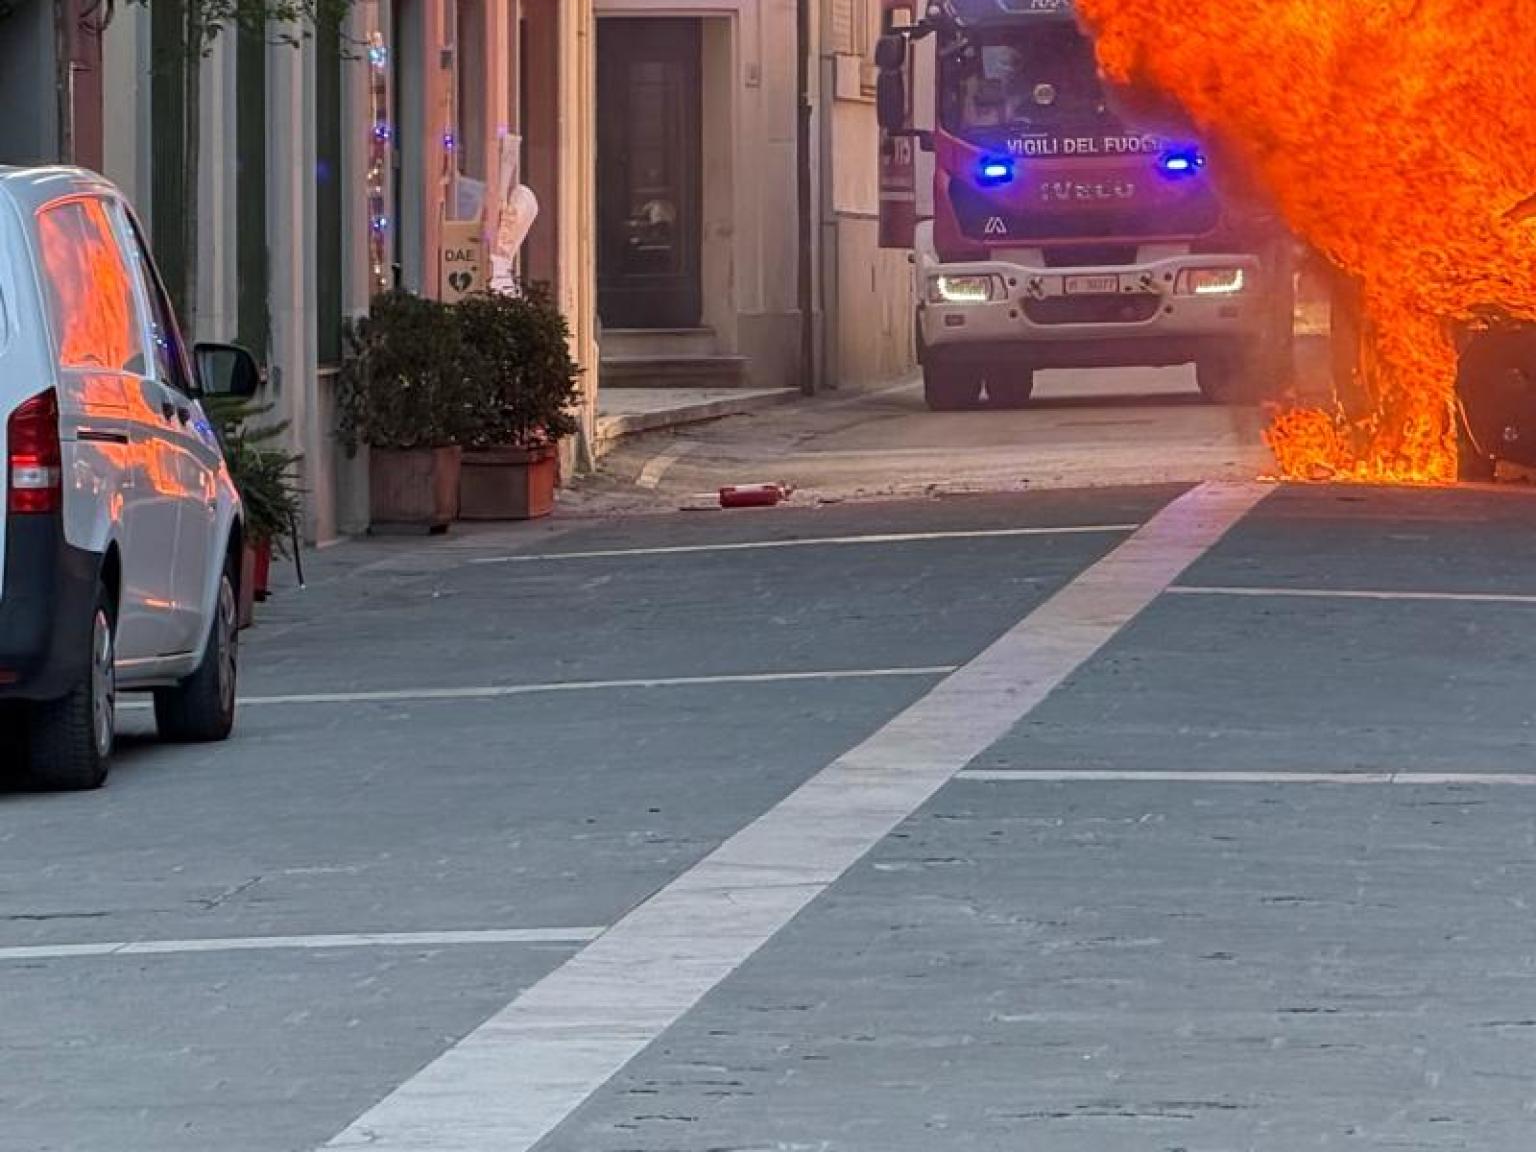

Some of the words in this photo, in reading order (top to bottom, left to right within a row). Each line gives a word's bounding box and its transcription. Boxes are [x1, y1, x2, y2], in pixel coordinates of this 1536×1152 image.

[1007, 138, 1058, 155] VIGILI
[1063, 137, 1099, 153] DEL
[445, 249, 476, 262] DAE
